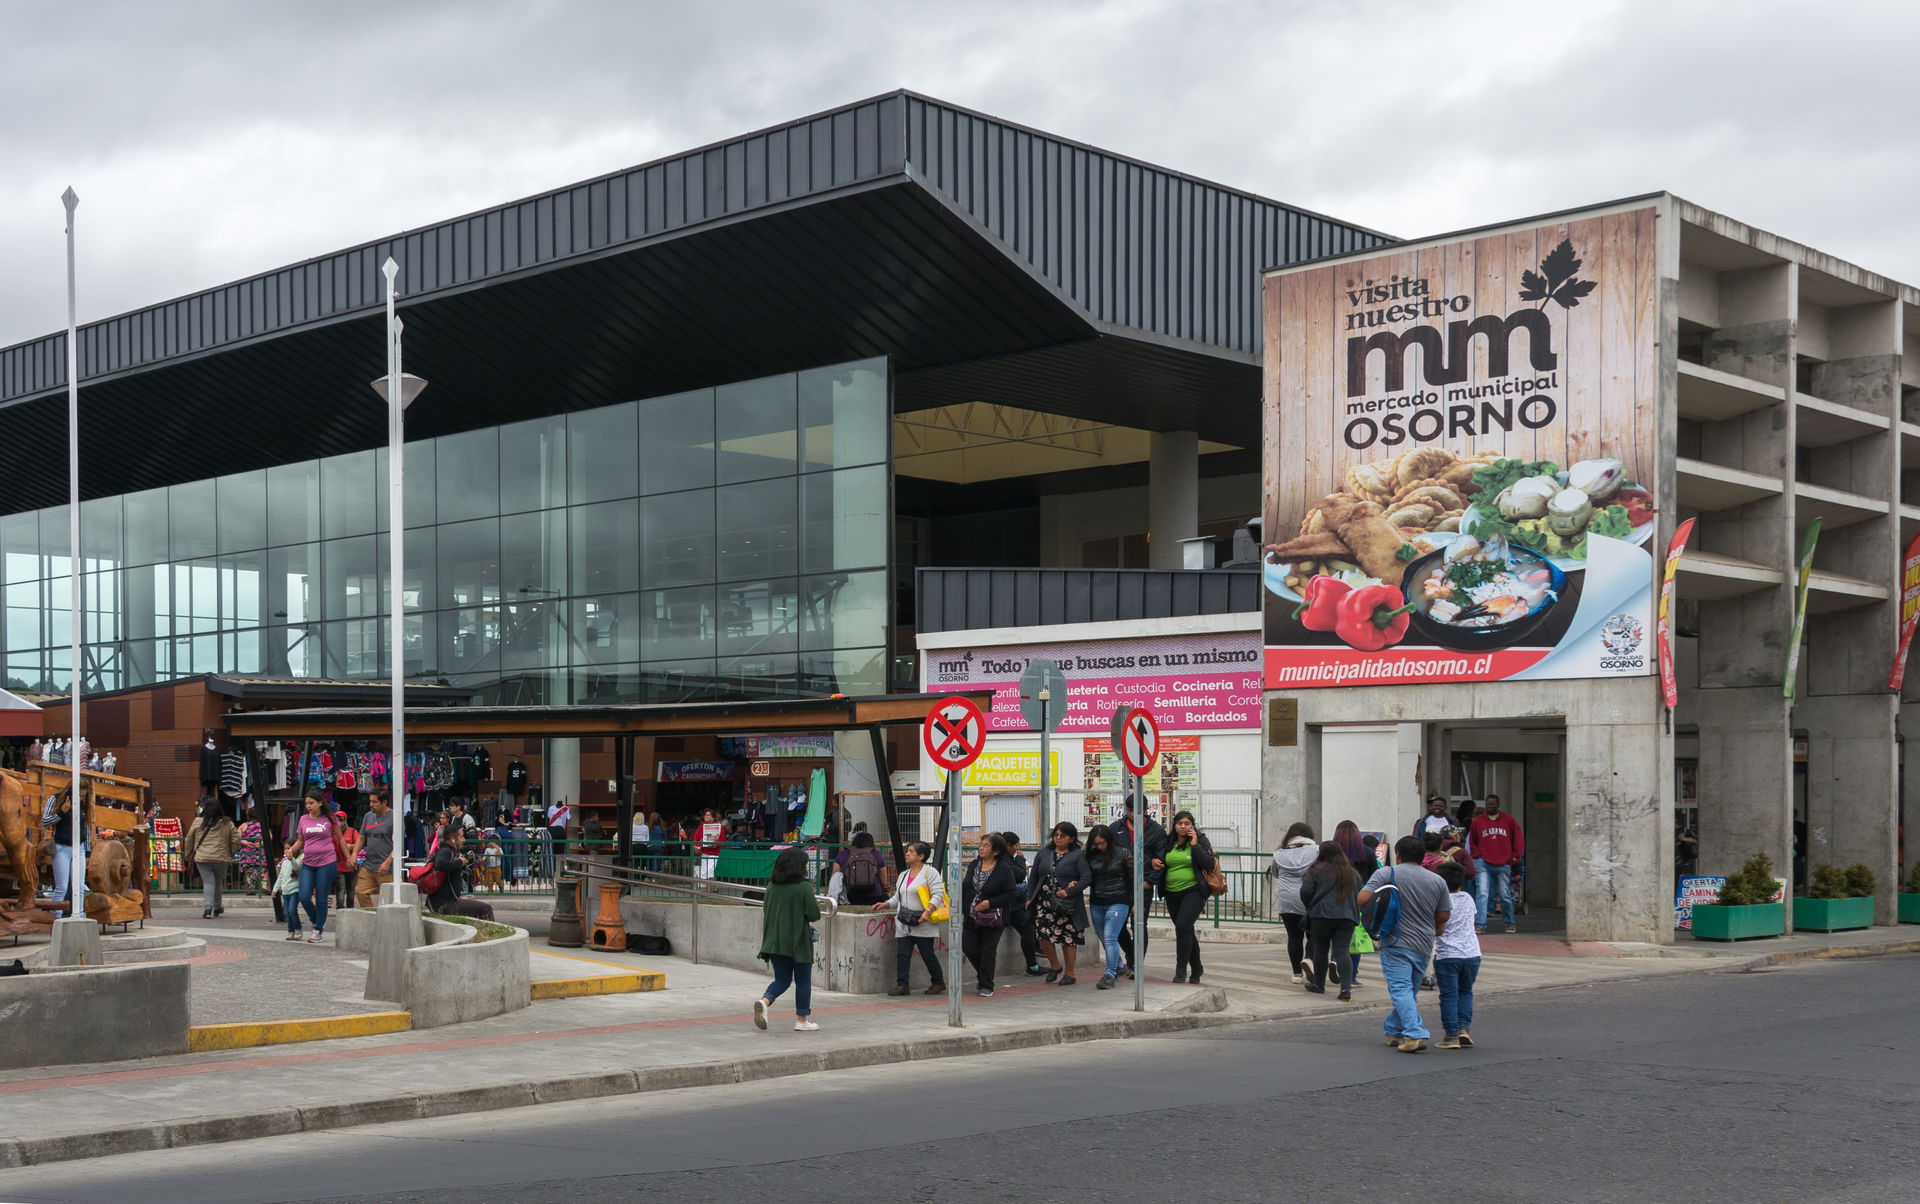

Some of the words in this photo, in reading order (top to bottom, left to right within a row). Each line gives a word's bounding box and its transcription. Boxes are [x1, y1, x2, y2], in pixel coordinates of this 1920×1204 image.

[1346, 275, 1429, 307] visita
[1345, 295, 1471, 330] nuestro
[1346, 390, 1439, 415] mercado
[1448, 372, 1559, 401] municipal
[1343, 394, 1557, 450] OSORNO
[981, 659, 1022, 674] Todo
[1054, 659, 1073, 671] ue
[1076, 656, 1135, 671] buscas
[1138, 655, 1161, 667] en
[1165, 653, 1190, 666] un
[1192, 648, 1258, 665] mismo
[1279, 654, 1493, 684] municipalidadosorno.cl
[1600, 660, 1644, 669] OSORNO
[938, 675, 970, 683] OSORNO
[992, 687, 1021, 698] onfit
[1067, 684, 1109, 696] uetería
[1114, 682, 1166, 694] Custodia
[1172, 679, 1234, 692] Cocinería
[1242, 677, 1262, 689] Rel
[991, 702, 1021, 712] elleza
[1066, 699, 1088, 710] ería
[1154, 696, 1217, 708] Semillería
[1059, 714, 1110, 726] ctrónica
[1185, 711, 1248, 723] Bordados
[976, 757, 1053, 770] PAQUETERI
[976, 772, 1027, 782] PACKAGE
[1683, 879, 1716, 887] OFERTA
[1678, 898, 1691, 907] DE
